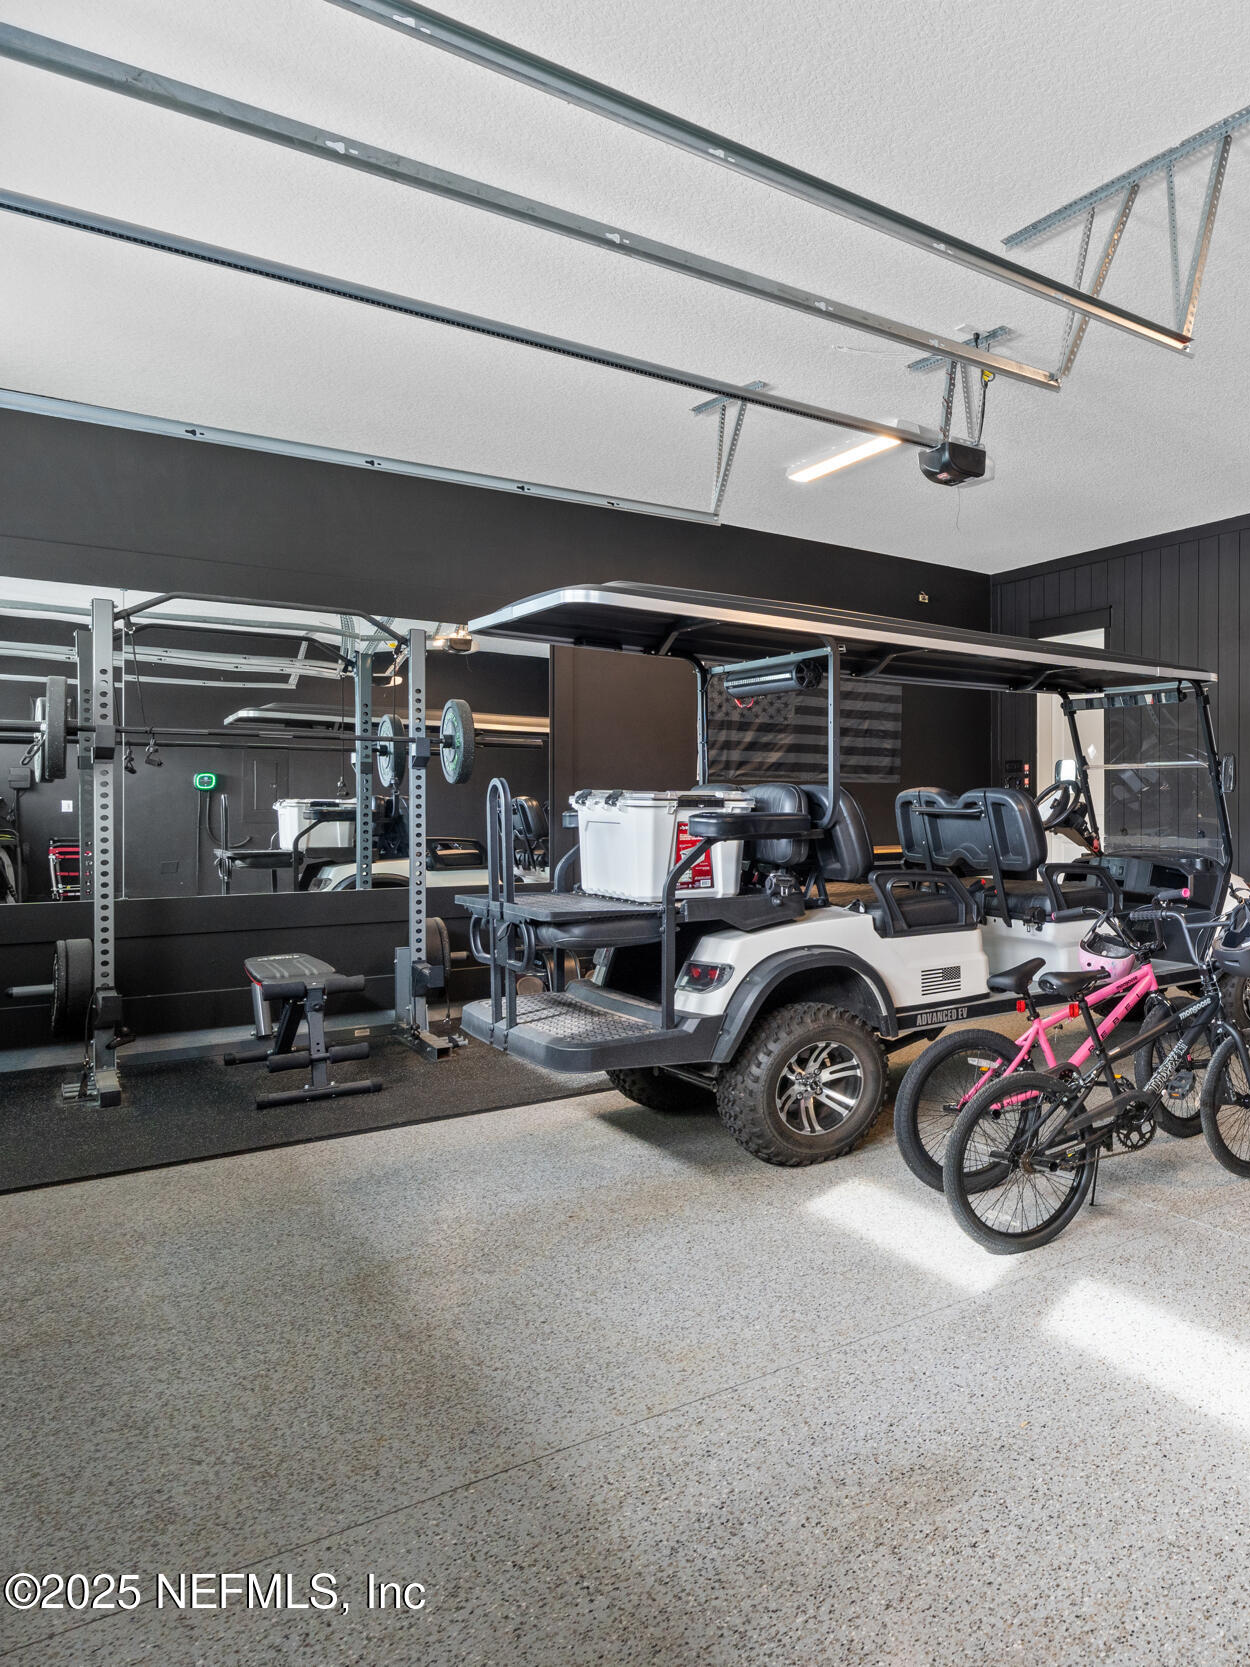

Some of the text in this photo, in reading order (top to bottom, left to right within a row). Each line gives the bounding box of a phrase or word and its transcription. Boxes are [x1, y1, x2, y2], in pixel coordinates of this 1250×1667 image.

[916, 1007, 968, 1026] ADVANCED EV
[1179, 997, 1212, 1020] mongoose
